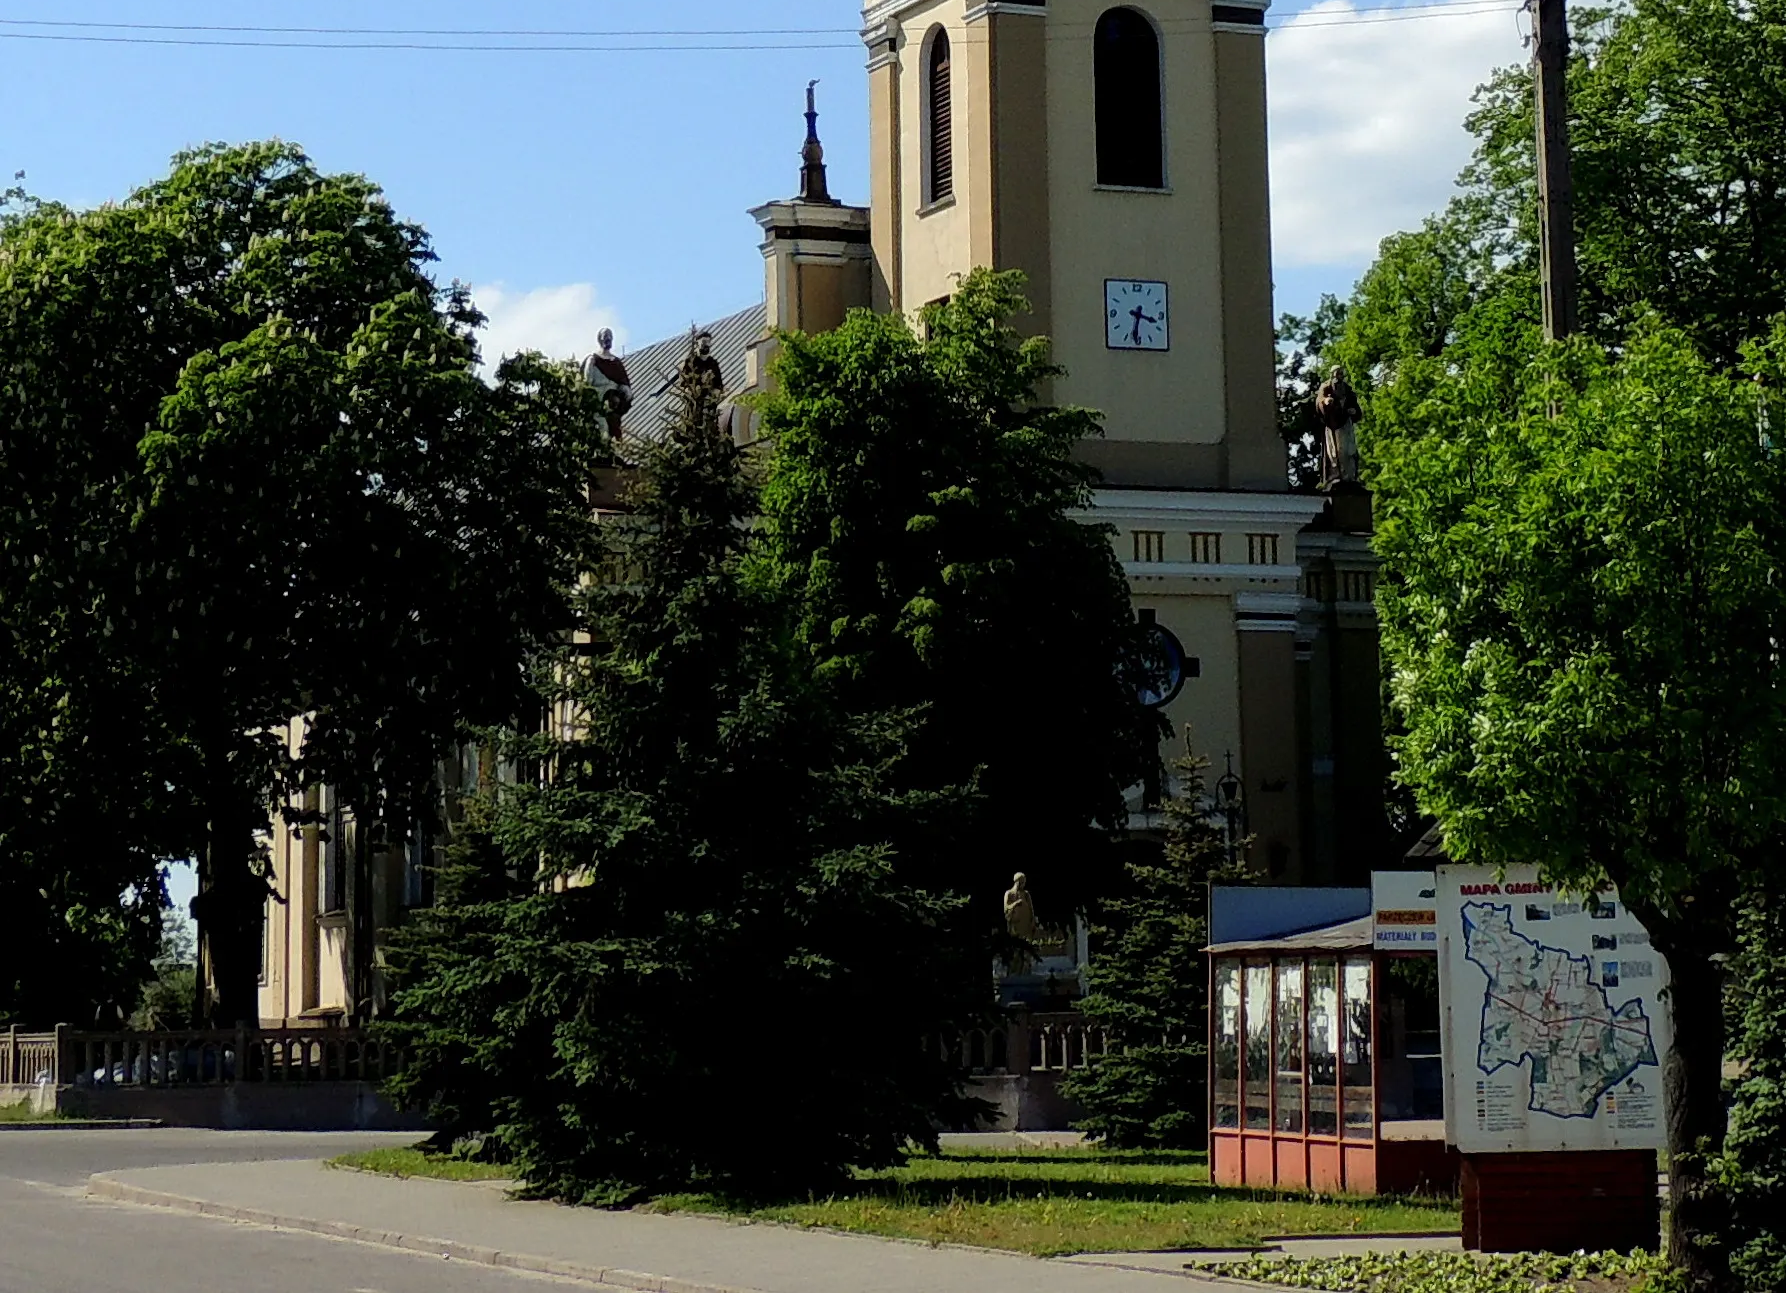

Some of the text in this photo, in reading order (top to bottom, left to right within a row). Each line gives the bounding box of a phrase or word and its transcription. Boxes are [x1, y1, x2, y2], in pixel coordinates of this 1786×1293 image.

[1110, 309, 1117, 318] 9
[1158, 311, 1164, 320] 3
[1460, 884, 1501, 895] MAPA
